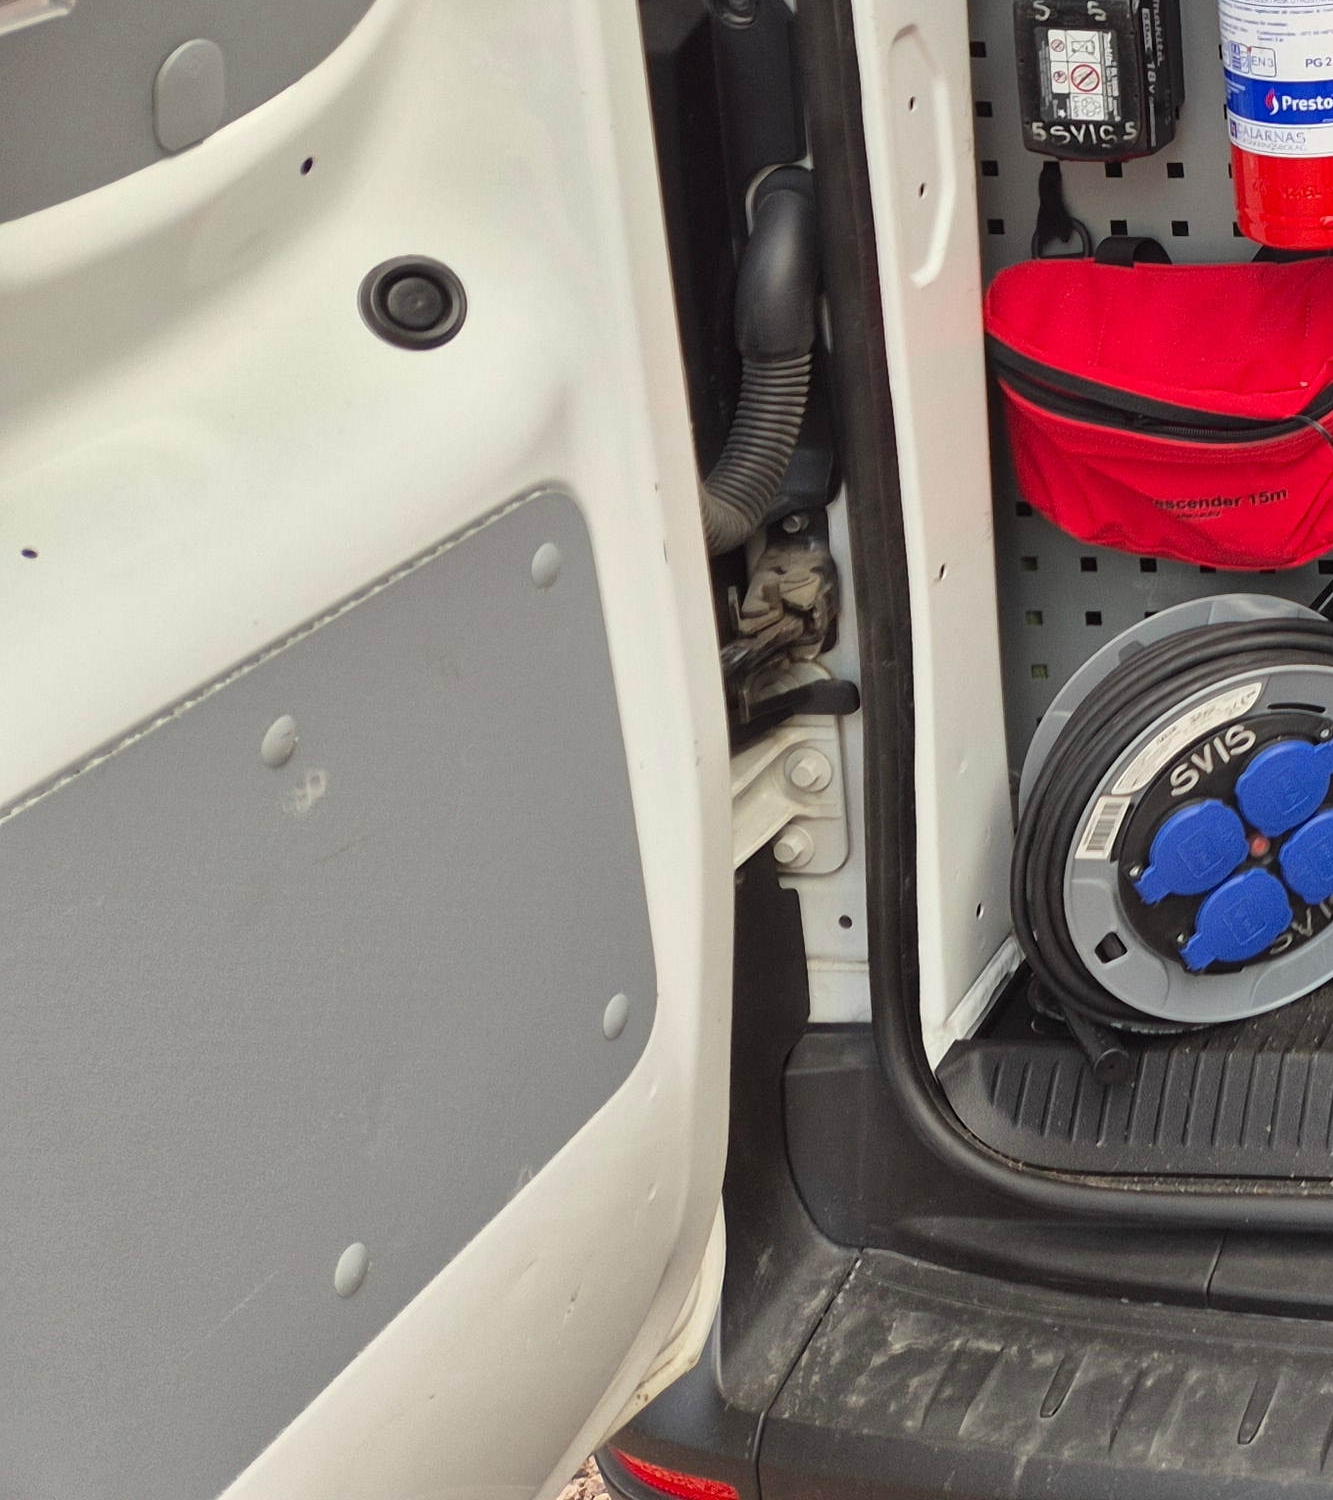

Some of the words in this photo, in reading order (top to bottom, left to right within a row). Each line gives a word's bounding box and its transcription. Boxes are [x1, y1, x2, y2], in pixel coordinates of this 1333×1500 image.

[1305, 57, 1323, 68] PG
[1325, 56, 1332, 67] 2
[1281, 95, 1333, 111] Presto
[1248, 489, 1287, 506] 15m
[1169, 724, 1257, 797] SVIS
